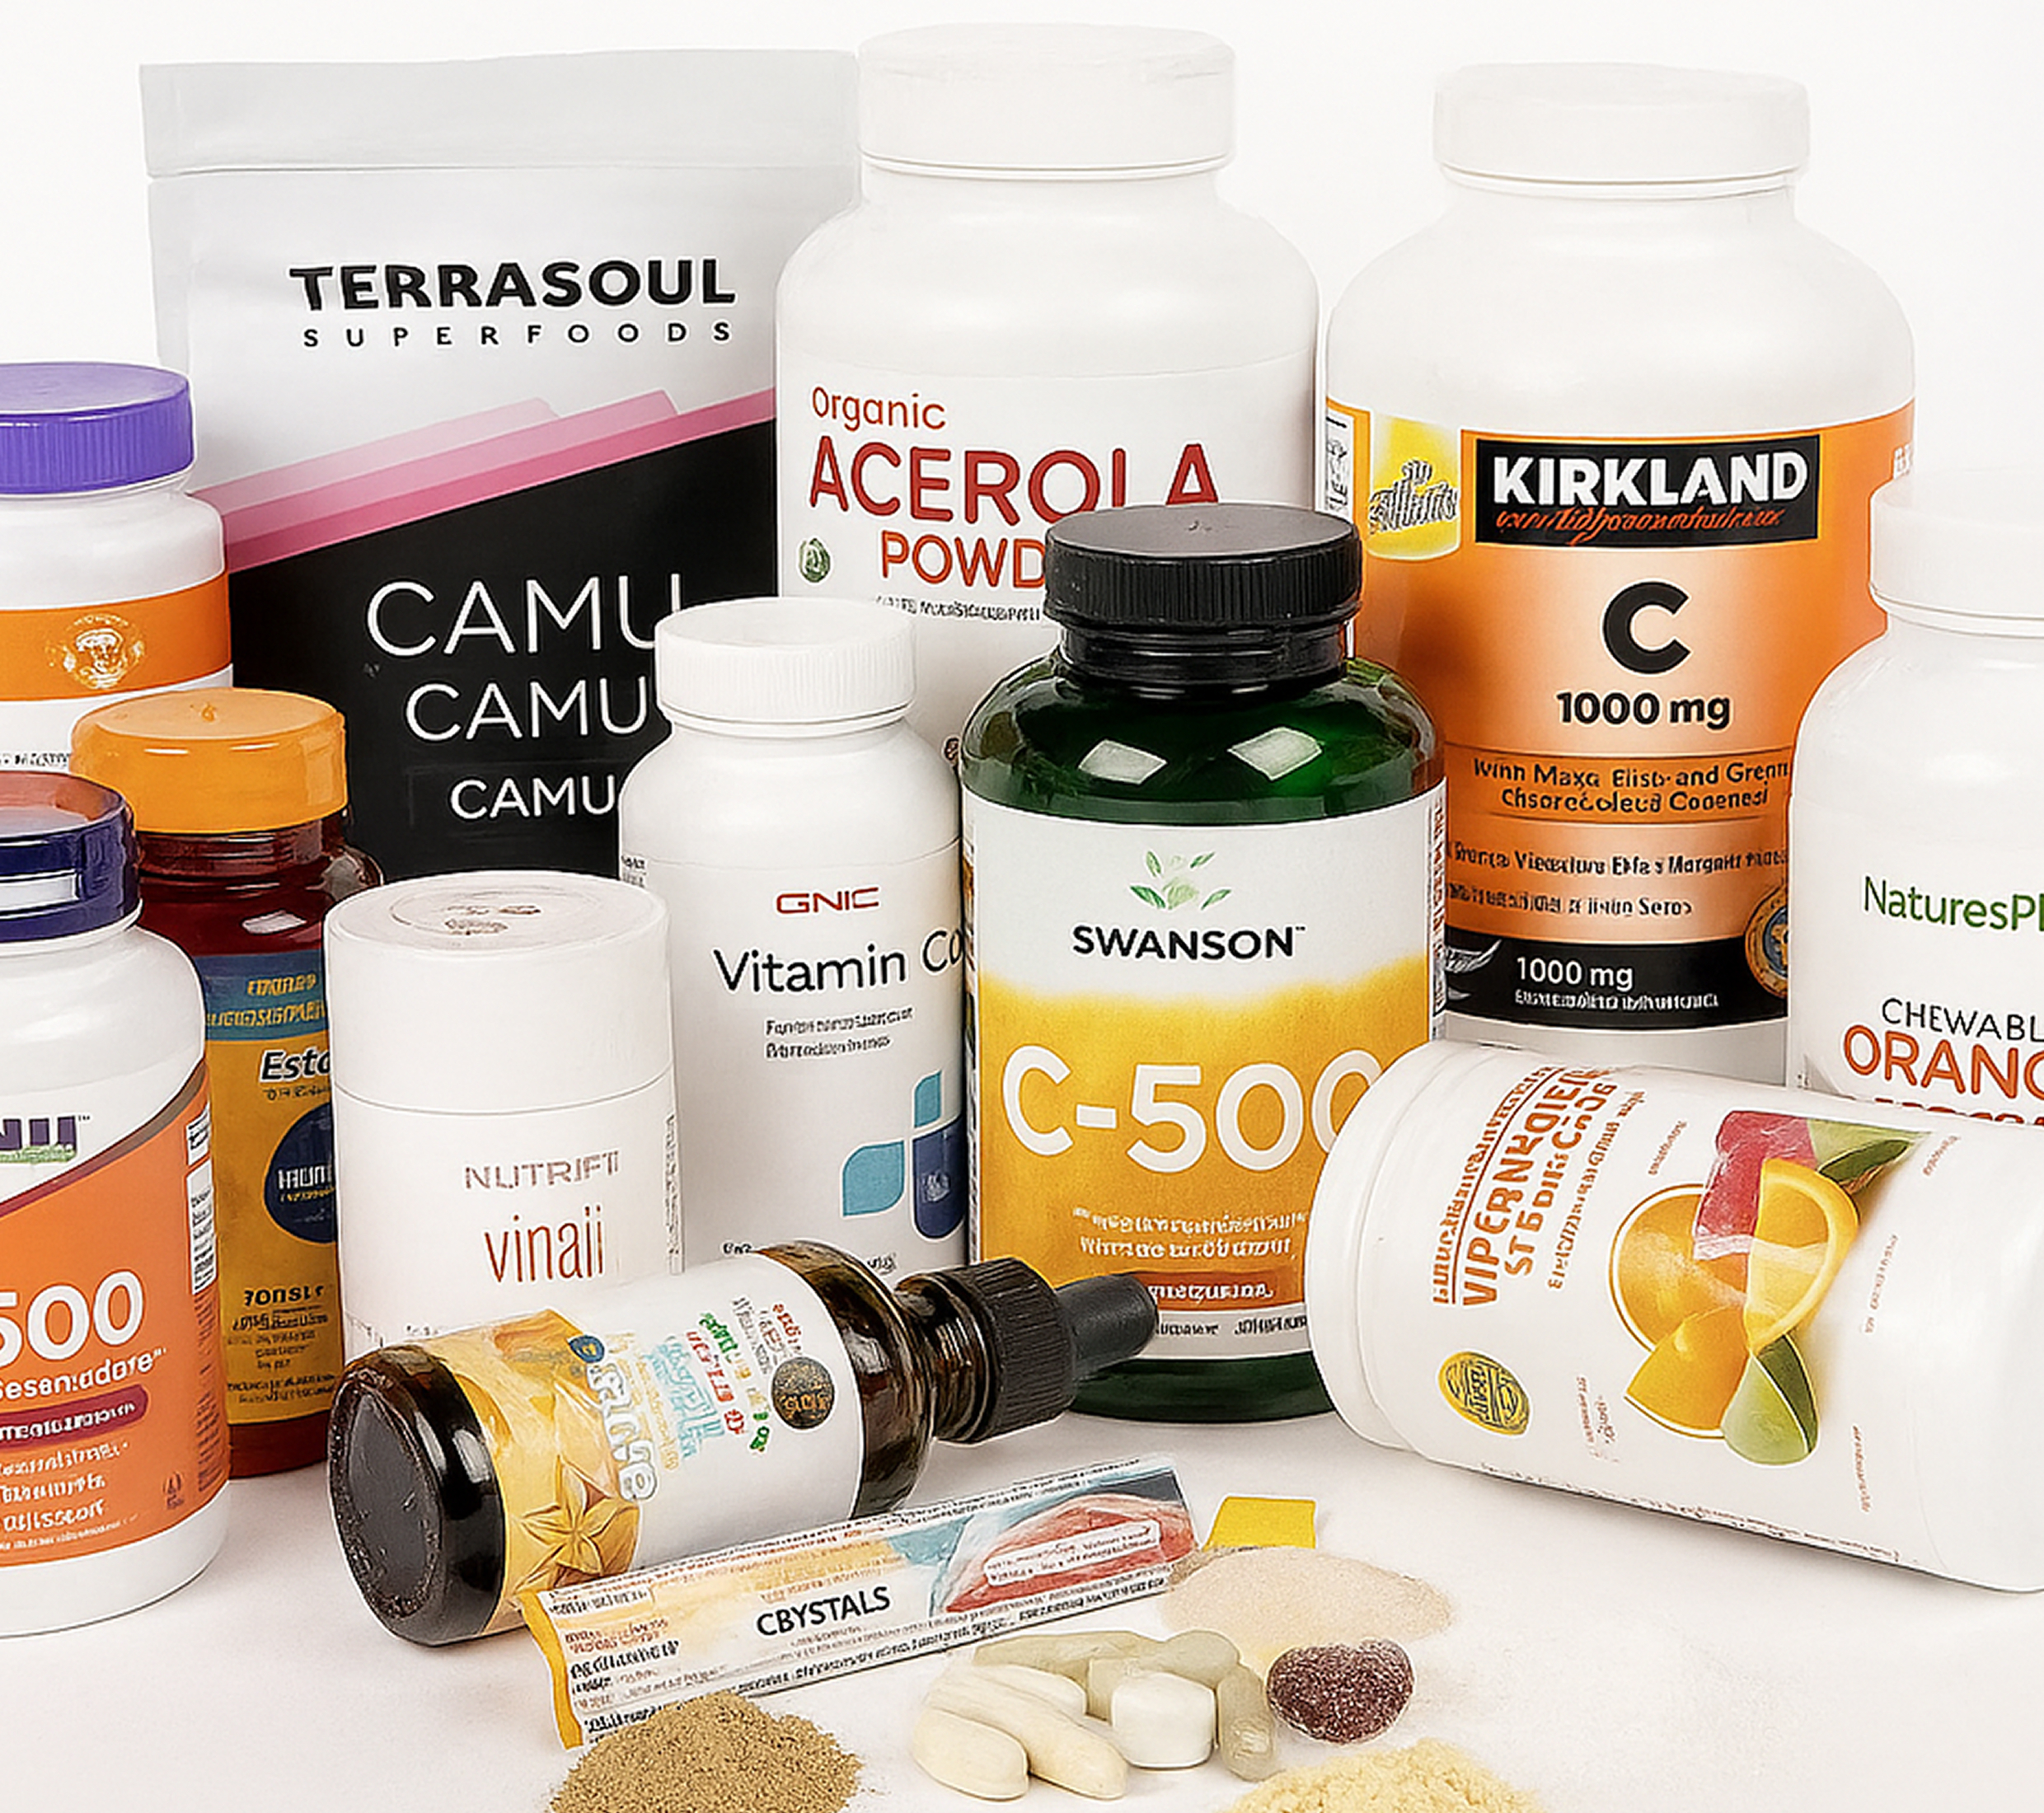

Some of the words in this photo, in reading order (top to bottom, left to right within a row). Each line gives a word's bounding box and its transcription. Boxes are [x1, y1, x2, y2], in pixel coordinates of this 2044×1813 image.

[290, 260, 735, 311] TERRASOUL
[303, 321, 731, 349] SUPERFOODS
[812, 386, 946, 430] Organic
[1493, 450, 1808, 507] KIRKLAND
[366, 574, 682, 657] CAMU
[1602, 580, 1690, 675] C
[405, 677, 648, 743] CAMU
[1556, 691, 1660, 725] 1000
[1670, 695, 1731, 730] mg
[450, 775, 615, 819] CAMU
[1676, 765, 1719, 785] and
[1073, 925, 1293, 960] SWANSON
[714, 944, 906, 991] Vitamin
[1517, 958, 1582, 985] 1000
[1590, 967, 1634, 992] mg
[1882, 997, 2044, 1042] CHEWABL
[1003, 1045, 1383, 1173] C-500
